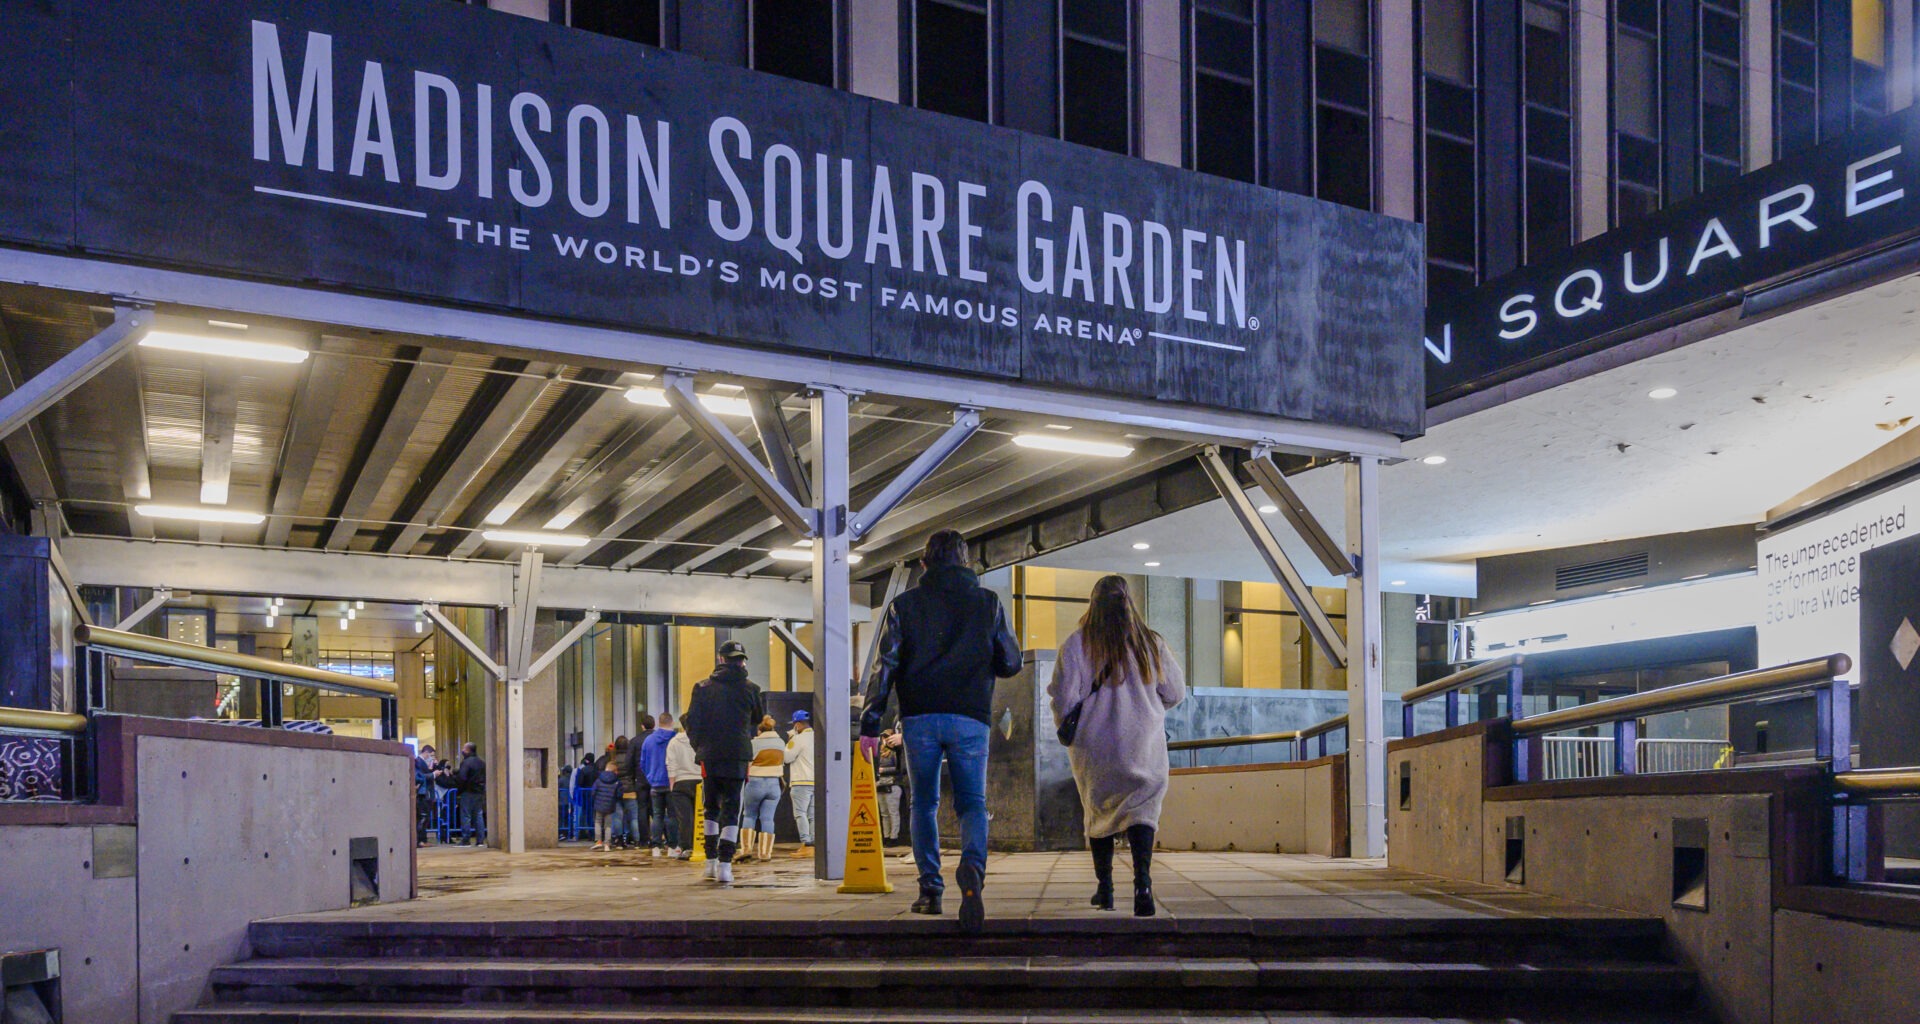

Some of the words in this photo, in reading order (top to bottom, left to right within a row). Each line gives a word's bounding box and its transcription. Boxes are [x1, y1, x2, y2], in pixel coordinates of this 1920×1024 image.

[252, 20, 670, 229] MADISON
[709, 117, 988, 282] SQUARE
[447, 217, 530, 250] THE
[552, 234, 739, 283] WORLD'S
[761, 268, 863, 302] MOST
[881, 288, 1018, 328] FAMOUS
[1499, 145, 1904, 340] SQUARE
[1766, 553, 1789, 574] The
[1791, 505, 1906, 564] unprecedented
[1767, 556, 1856, 597] performance
[1787, 596, 1819, 620] Ultra
